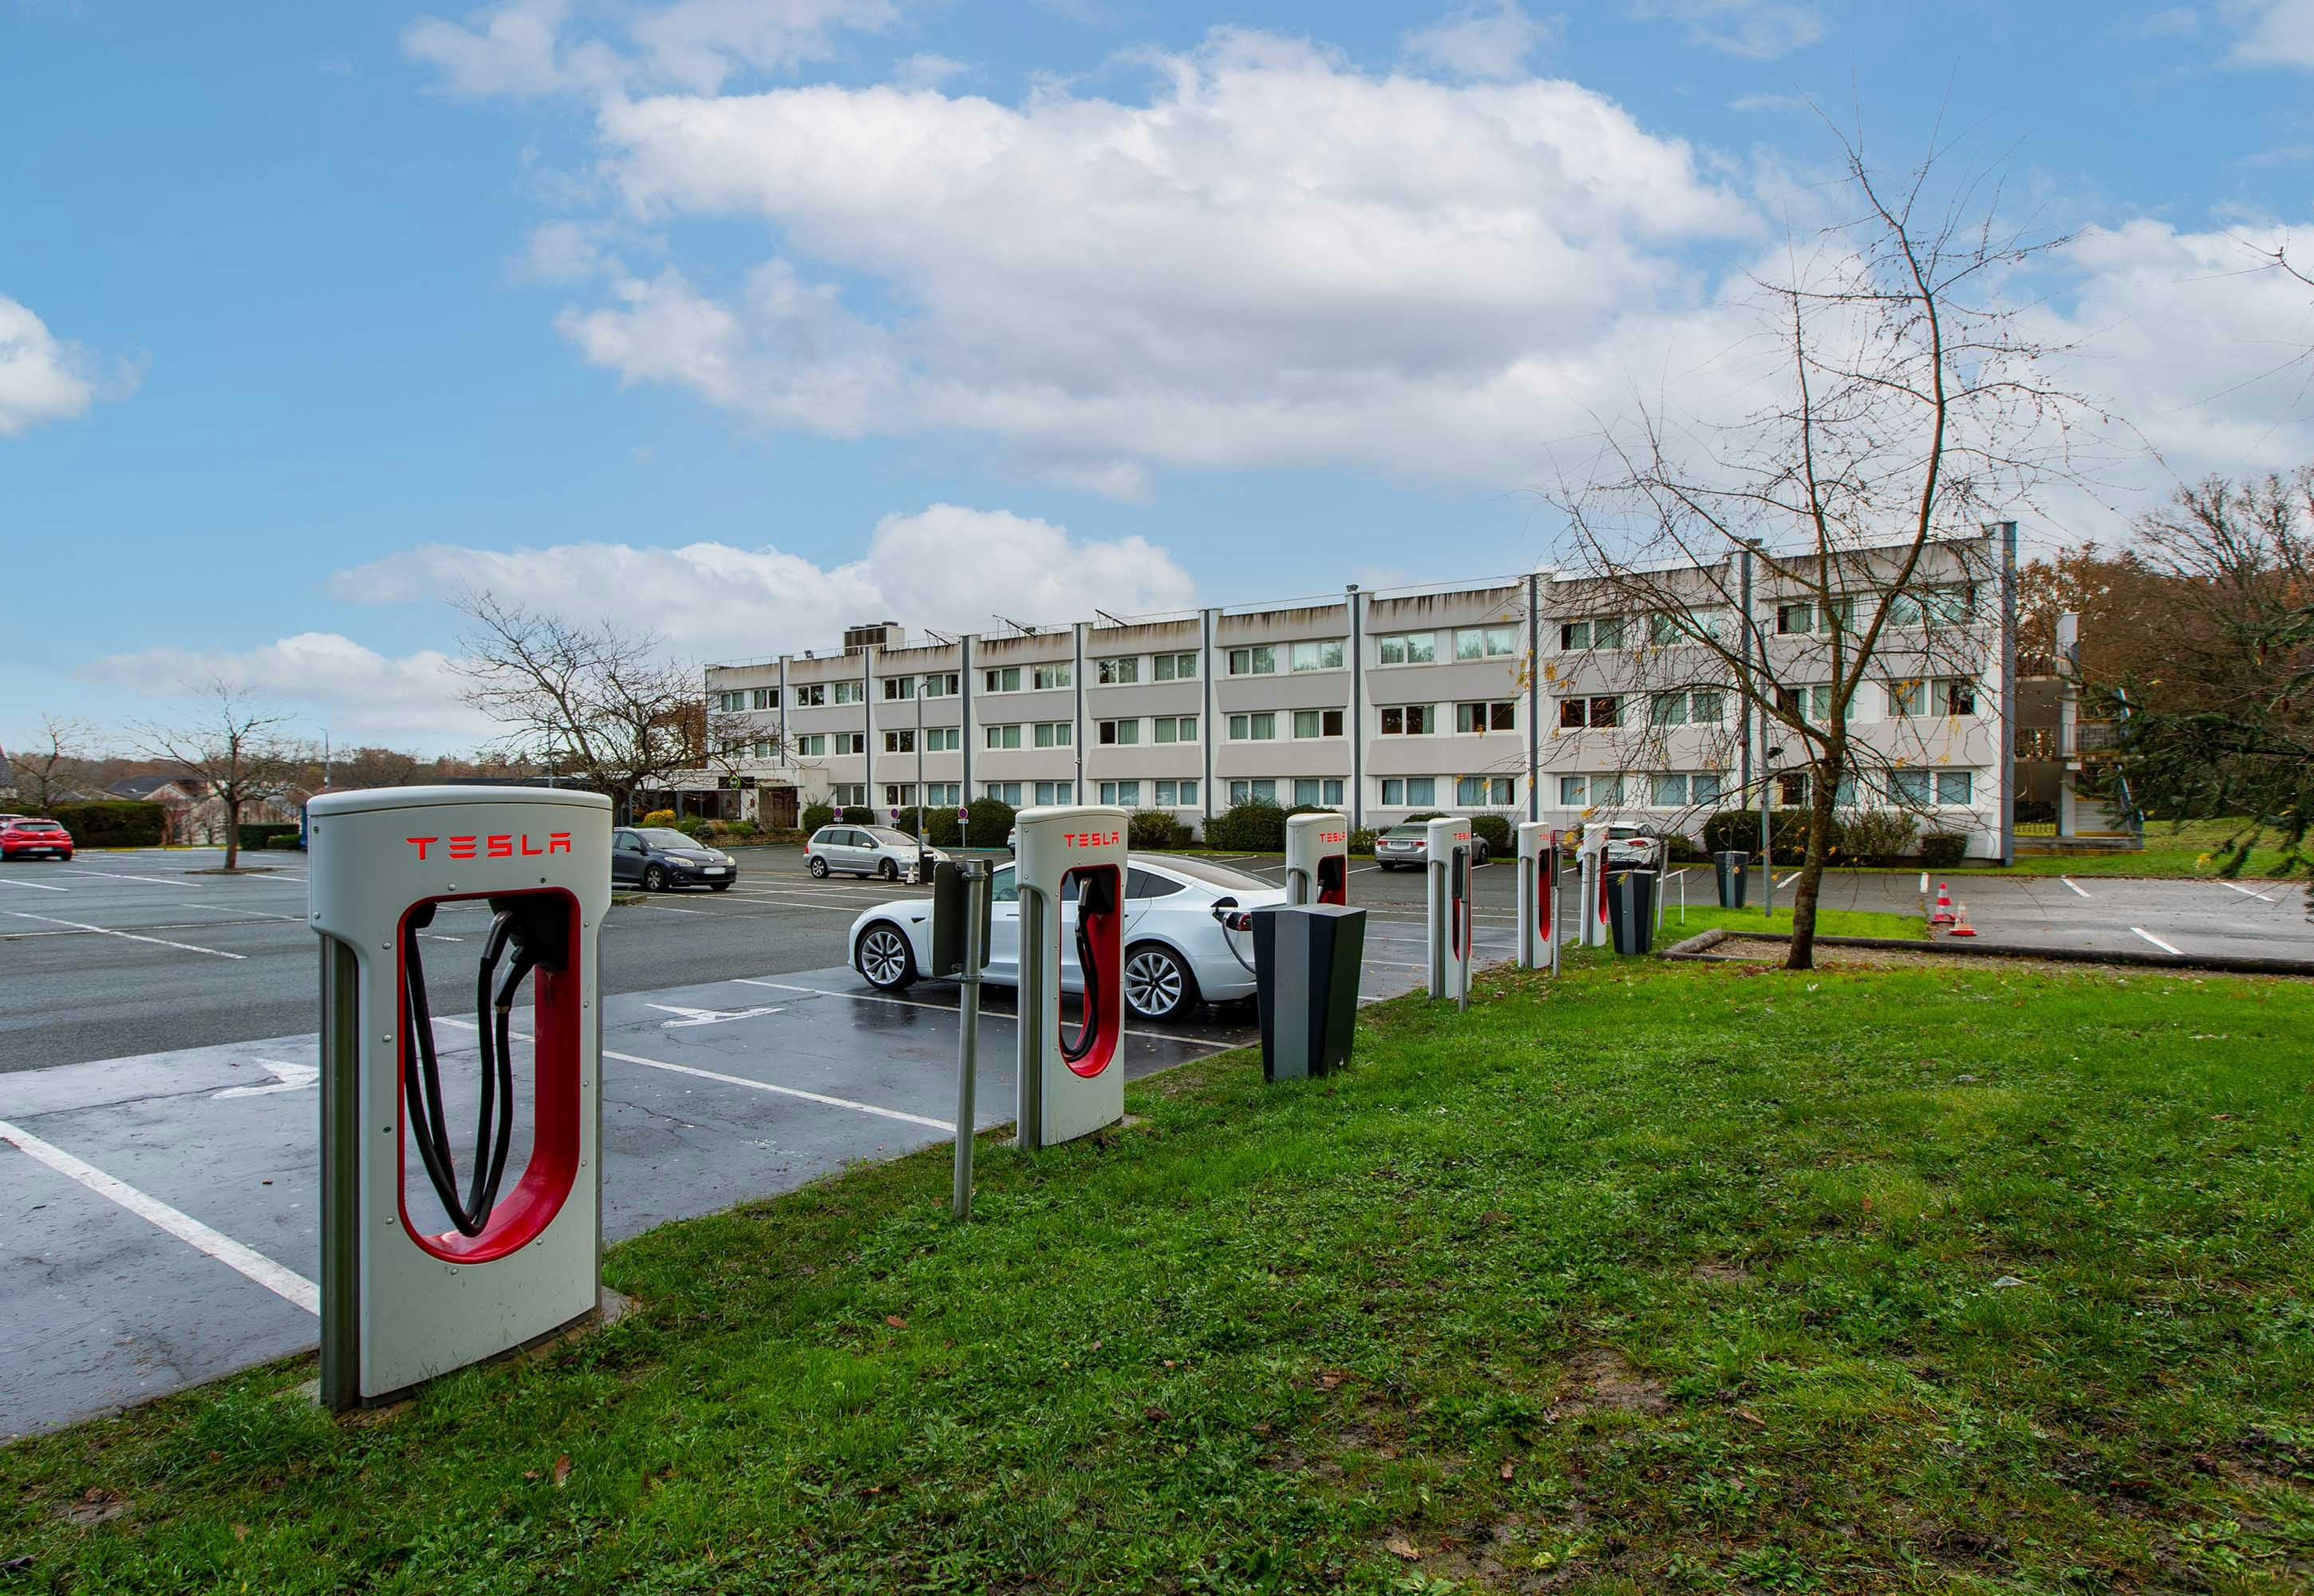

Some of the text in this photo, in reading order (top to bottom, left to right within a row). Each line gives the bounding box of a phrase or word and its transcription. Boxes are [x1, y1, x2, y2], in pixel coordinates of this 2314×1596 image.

[405, 832, 571, 860] TESLA
[1063, 831, 1119, 848] TESLA
[1319, 832, 1345, 843] TESLA
